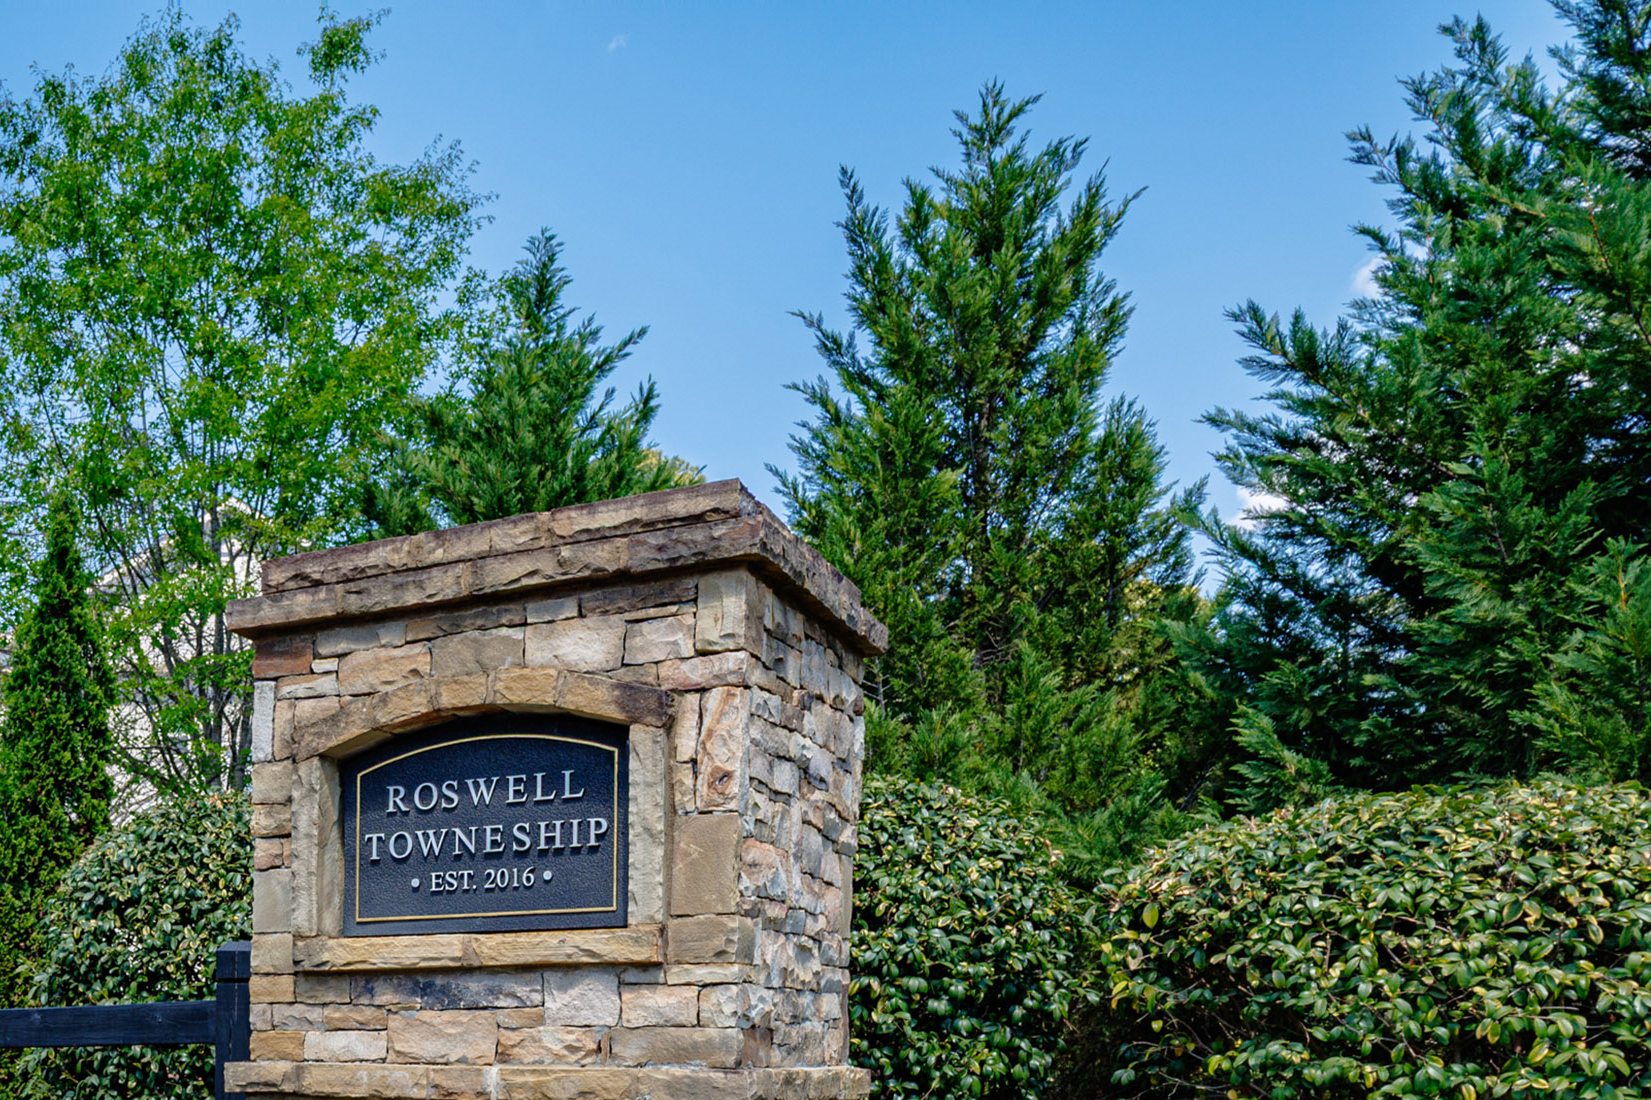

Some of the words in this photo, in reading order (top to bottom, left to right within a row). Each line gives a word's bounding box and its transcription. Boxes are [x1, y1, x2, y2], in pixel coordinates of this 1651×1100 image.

[386, 769, 585, 813] ROSWELL
[364, 817, 608, 861] TOWNESHIP
[430, 871, 477, 892] EST.
[484, 866, 535, 889] 2016
